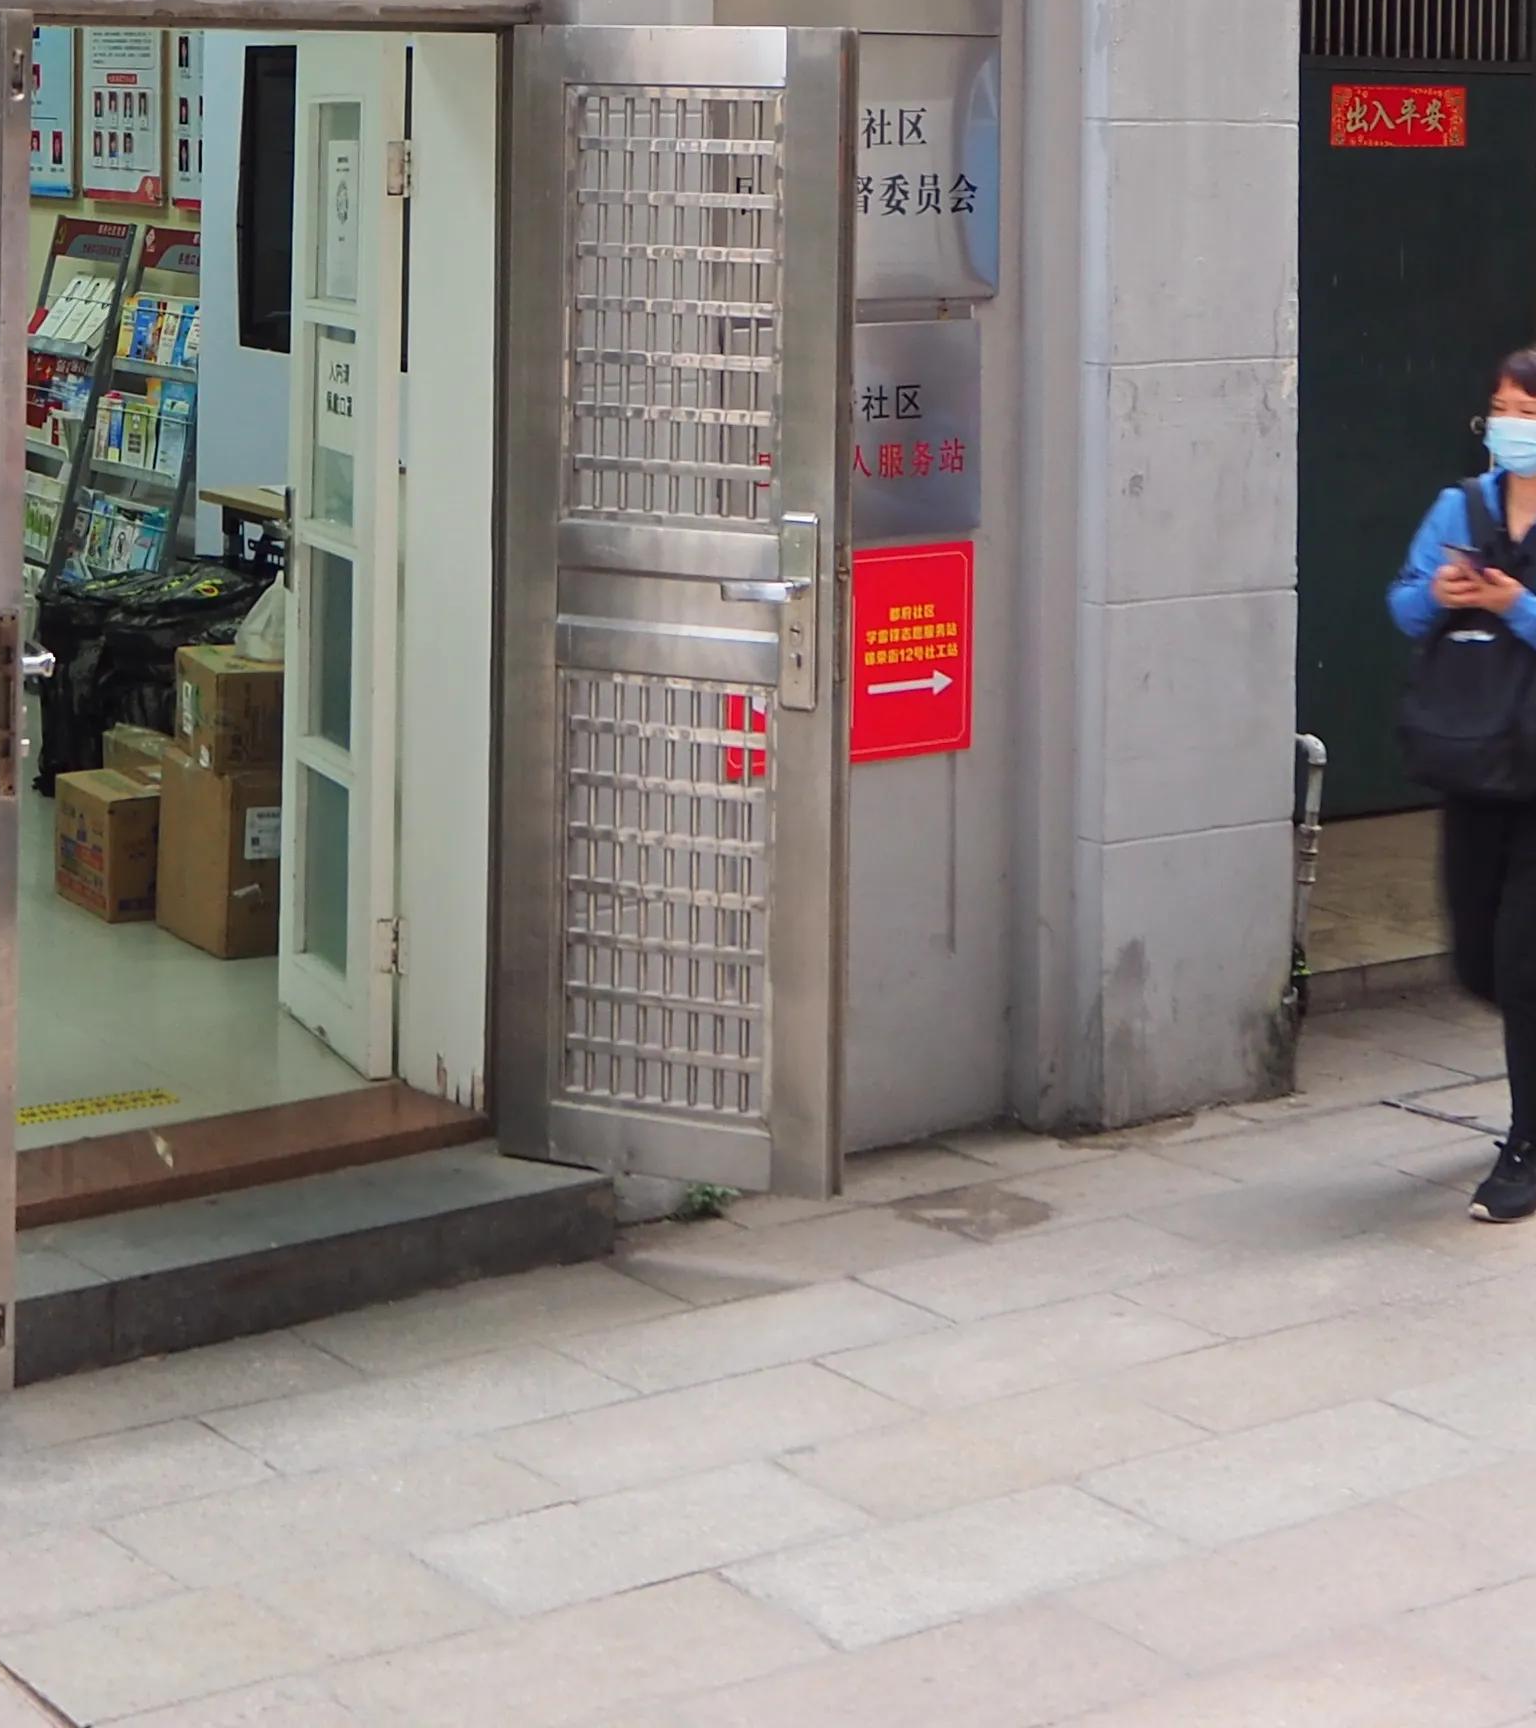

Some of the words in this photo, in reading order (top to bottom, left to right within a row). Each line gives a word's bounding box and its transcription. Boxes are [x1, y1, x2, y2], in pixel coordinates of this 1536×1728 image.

[861, 107, 928, 149] 社区
[1346, 96, 1447, 136] 出入平安
[861, 384, 923, 422] 社区
[852, 438, 965, 477] 人服务站
